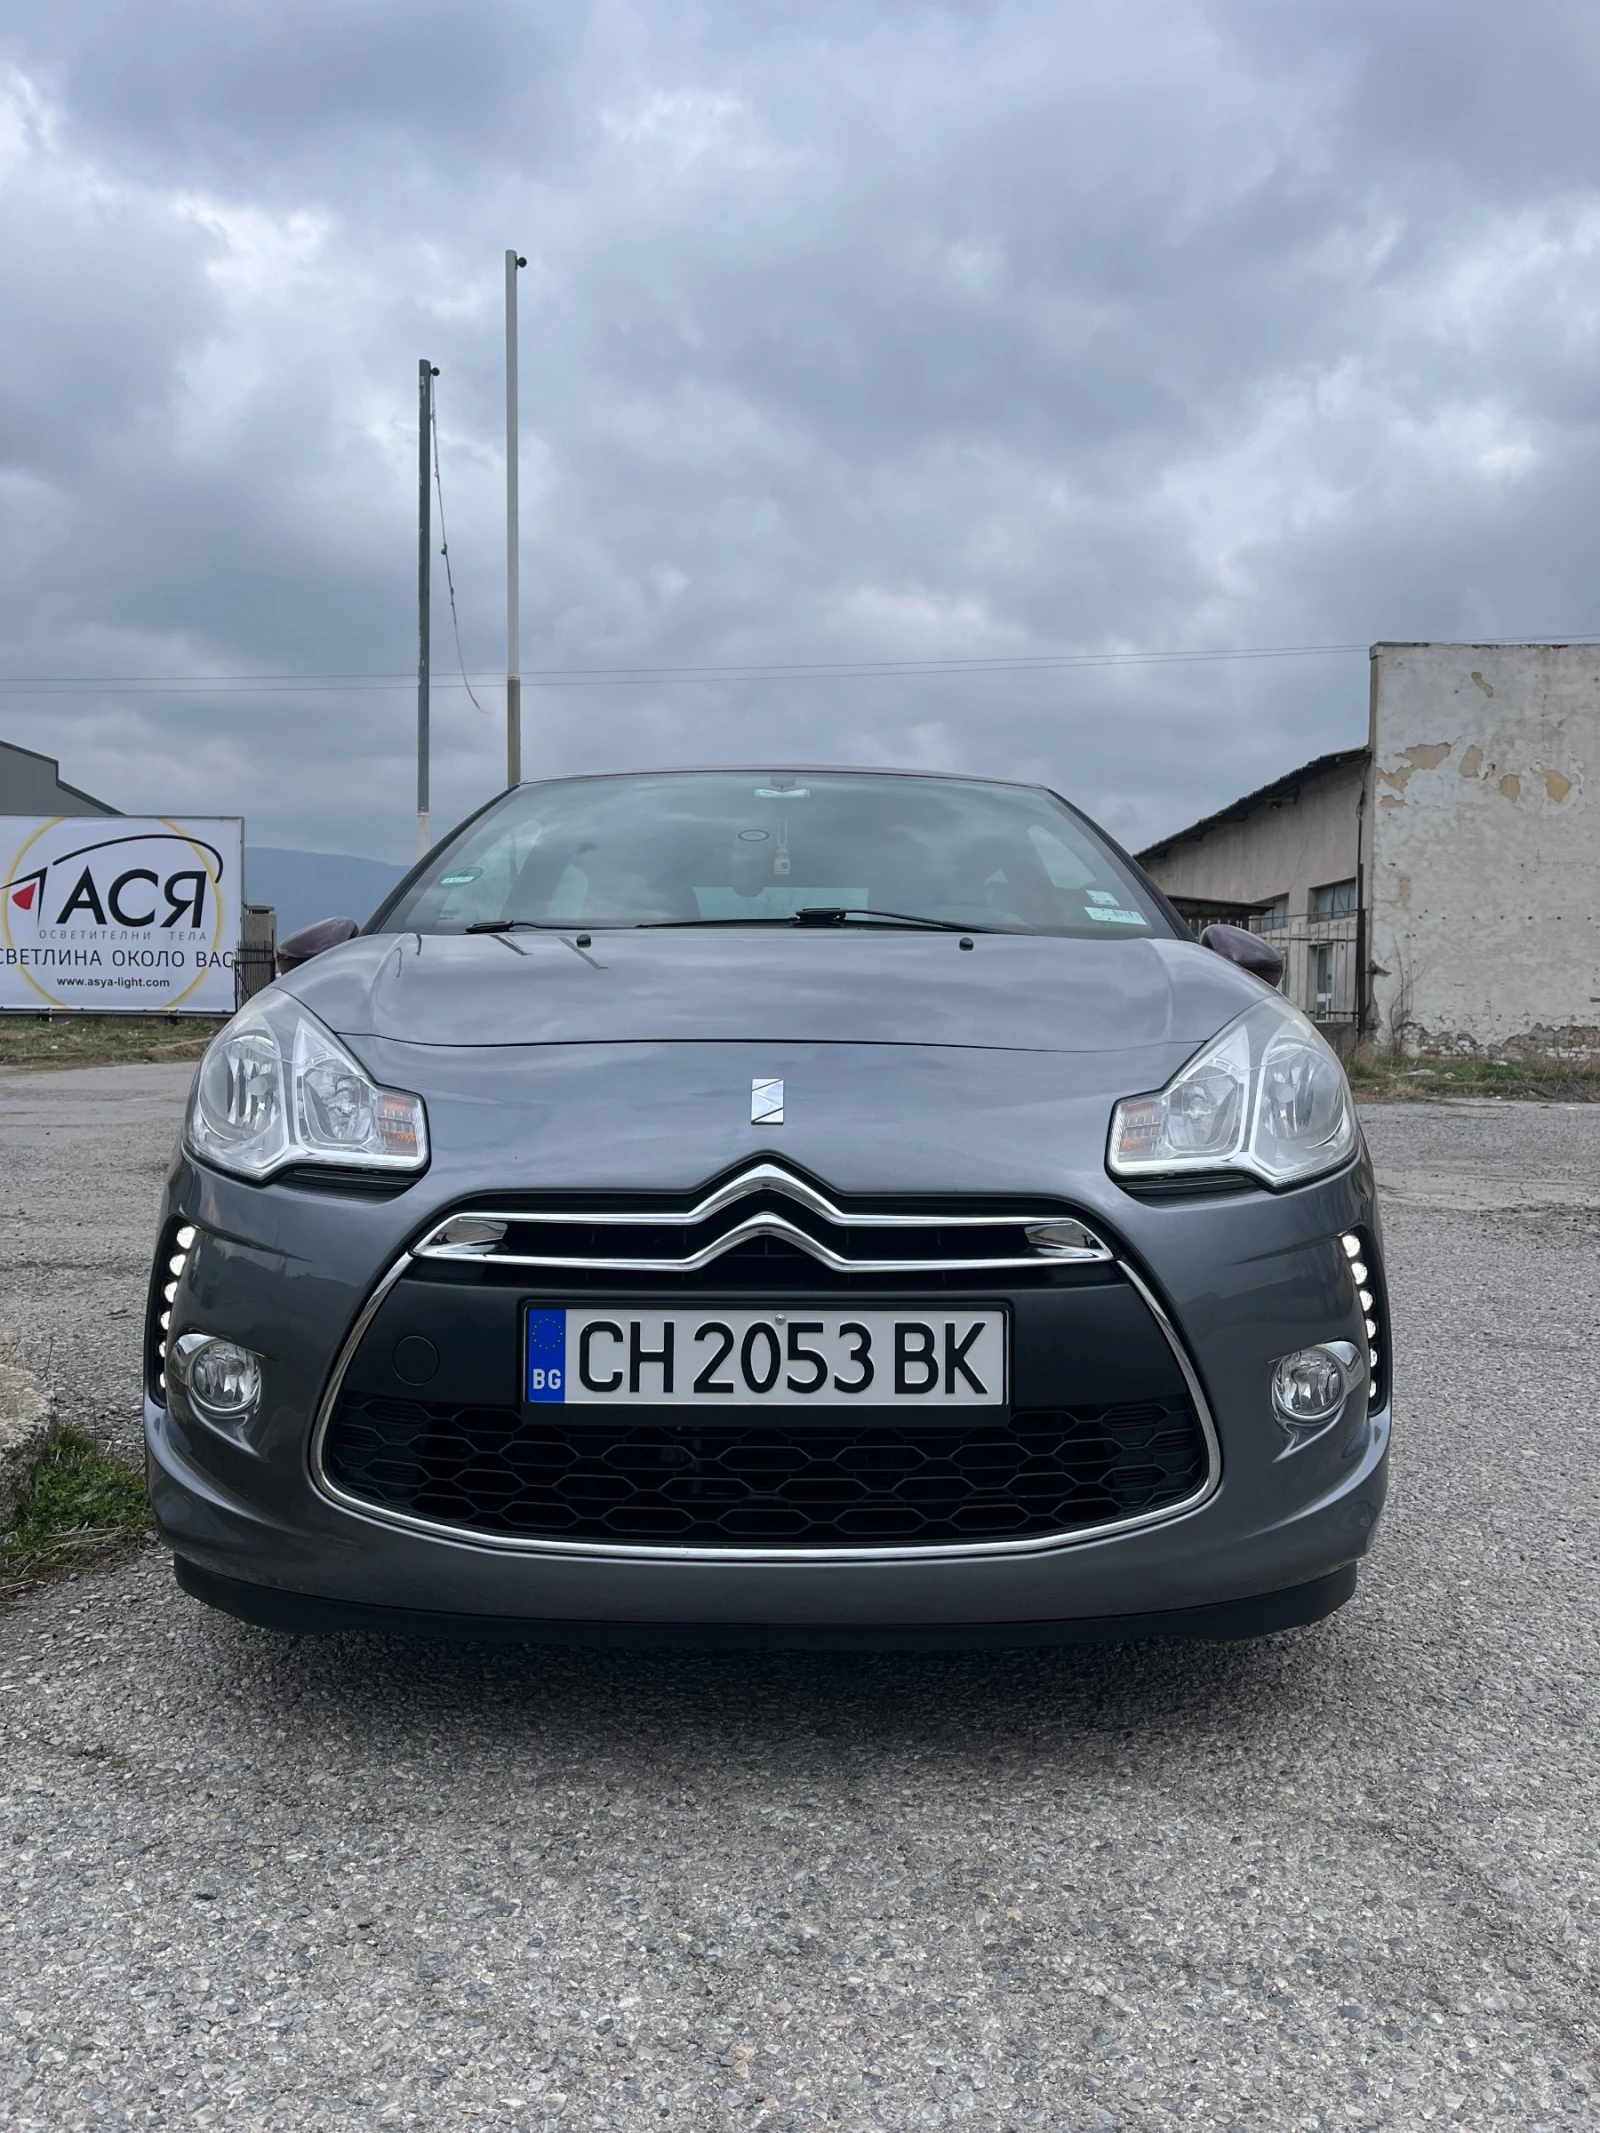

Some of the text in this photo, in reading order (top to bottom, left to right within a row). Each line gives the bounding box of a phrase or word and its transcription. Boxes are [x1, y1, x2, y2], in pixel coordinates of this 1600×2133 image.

[56, 865, 207, 928] АСЯ
[39, 930, 206, 941] ОСВЕТИТЕЛНИ ТЕЛА
[112, 950, 185, 968] ОКОЛО
[196, 951, 233, 968] ВАС
[57, 977, 170, 989] www.asya-light.com
[694, 1322, 874, 1394] 2053
[532, 1368, 561, 1390] BG
